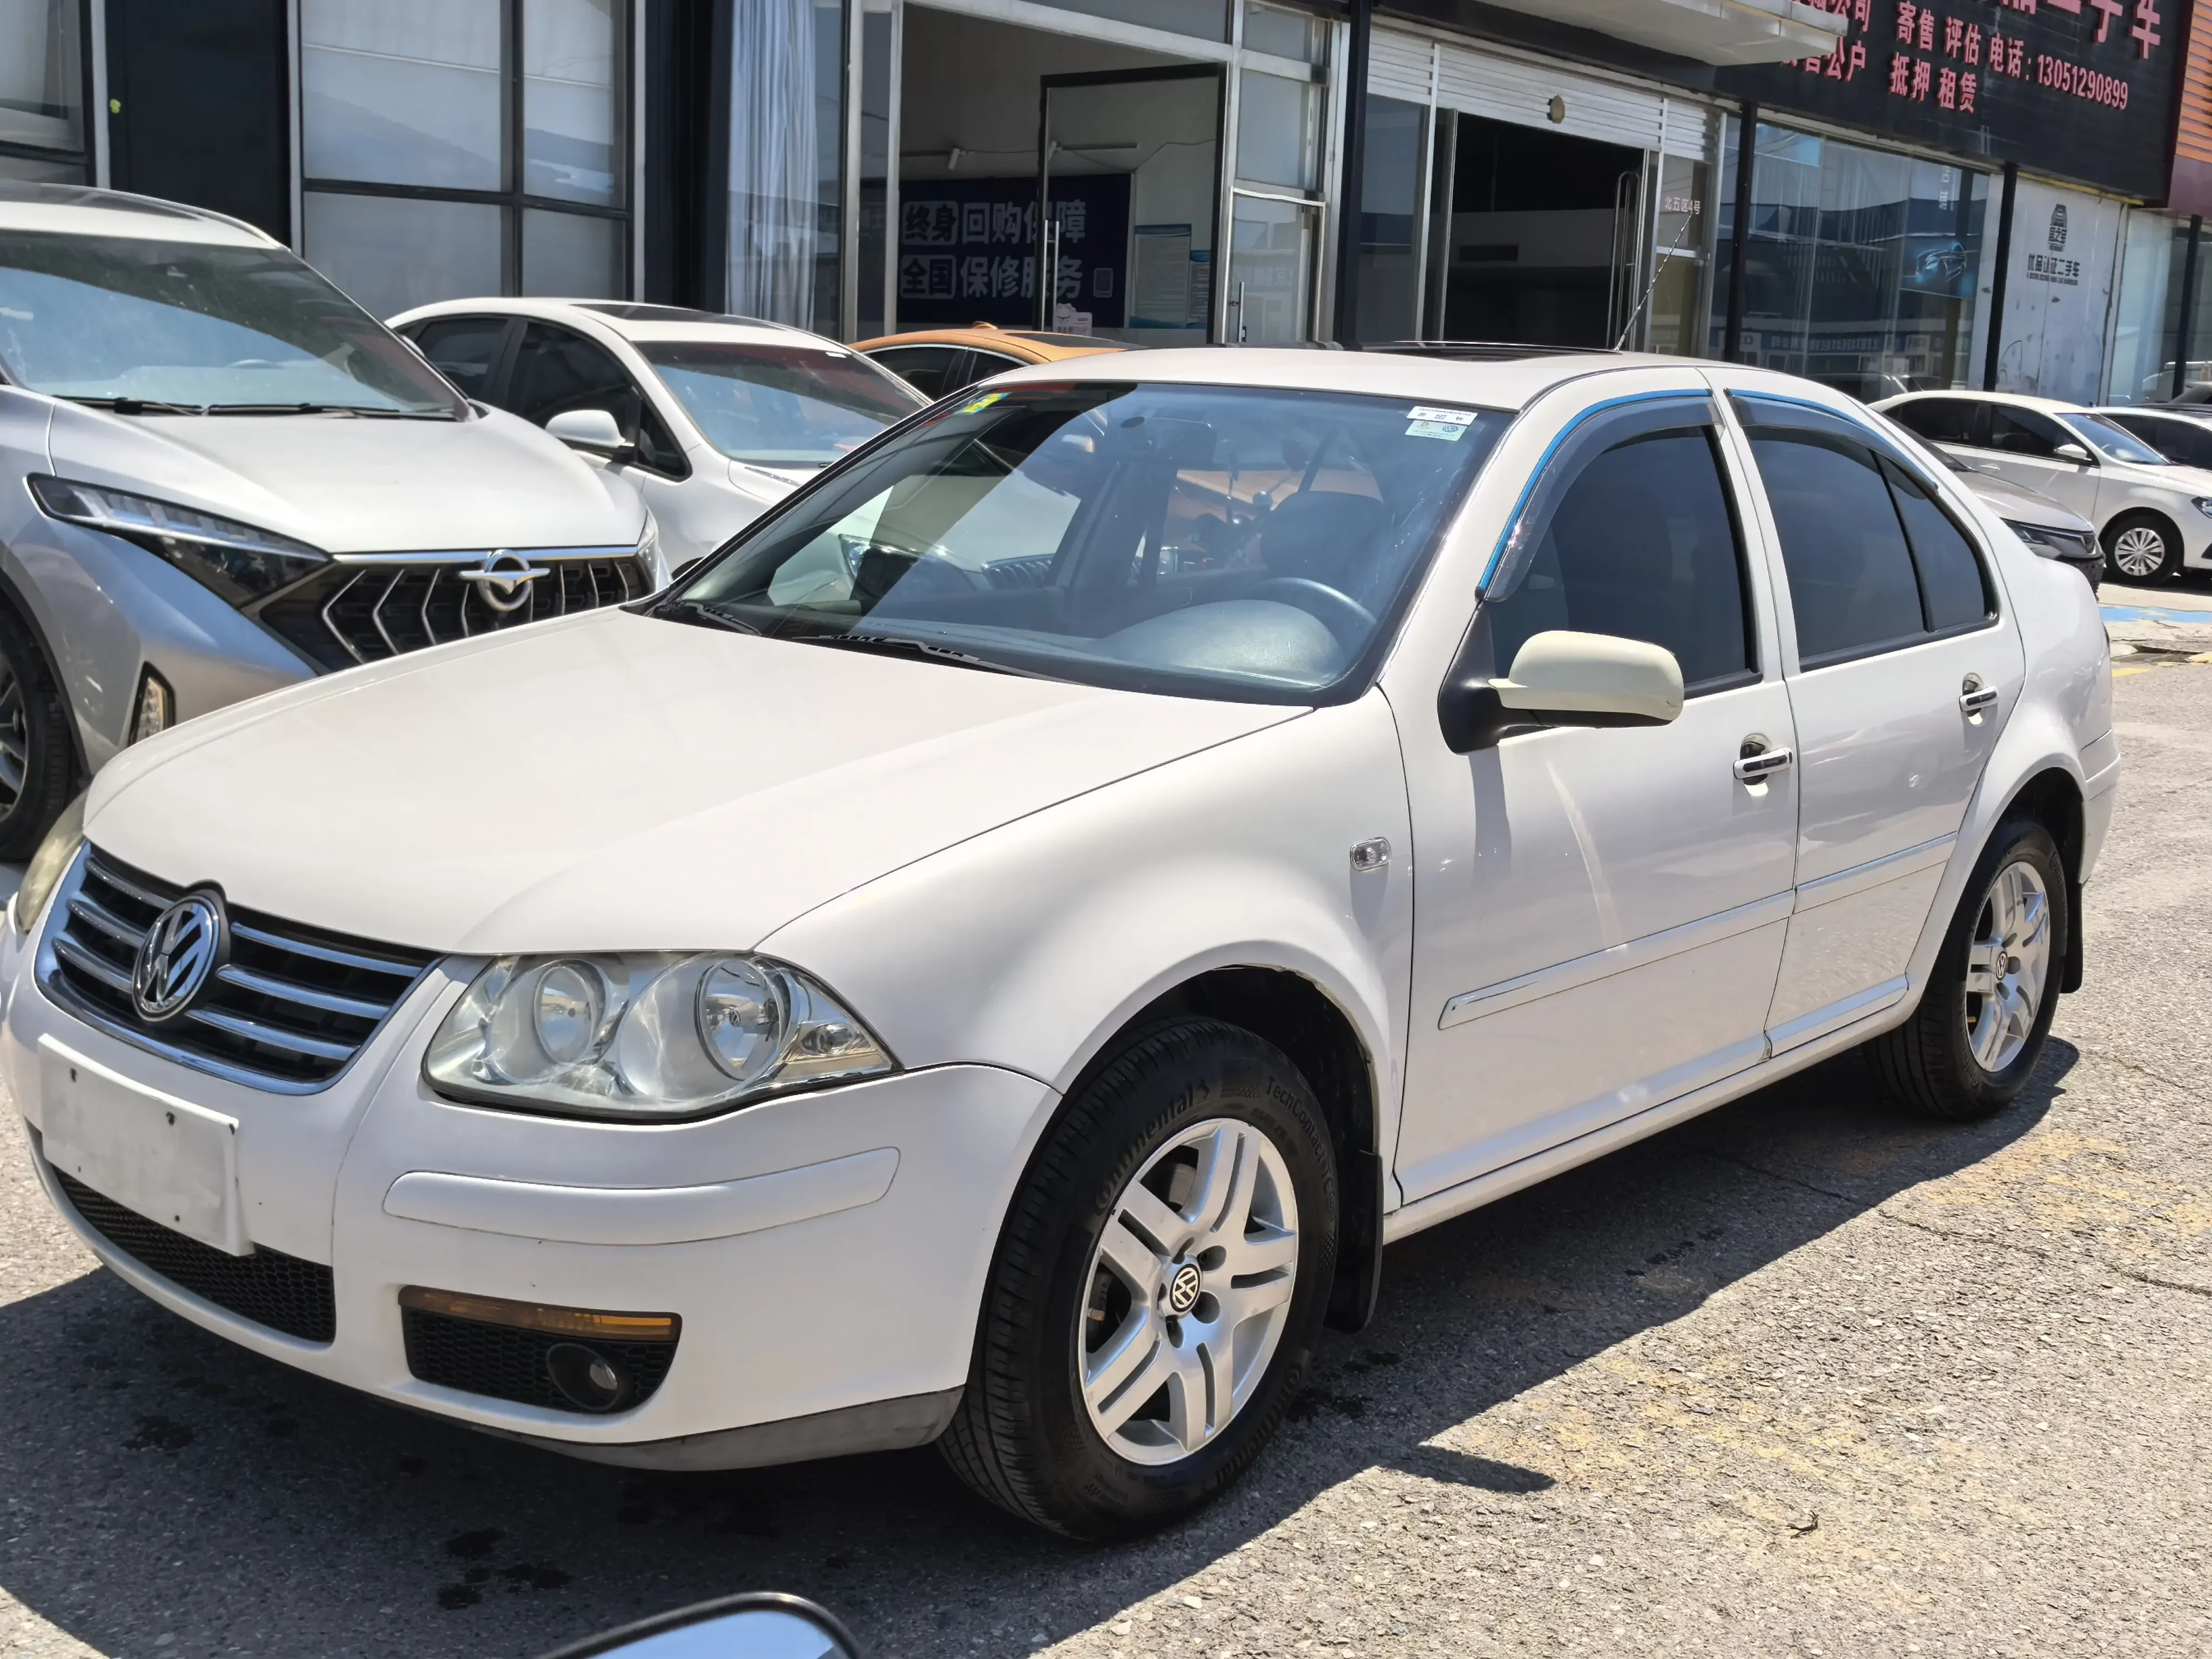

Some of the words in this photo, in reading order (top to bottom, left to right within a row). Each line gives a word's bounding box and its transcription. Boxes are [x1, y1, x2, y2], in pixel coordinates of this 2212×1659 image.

[1896, 1, 1935, 51] 寄售
[1944, 16, 1981, 65] 评估
[1890, 52, 1931, 103] 抵押
[1938, 67, 1977, 113] 租赁
